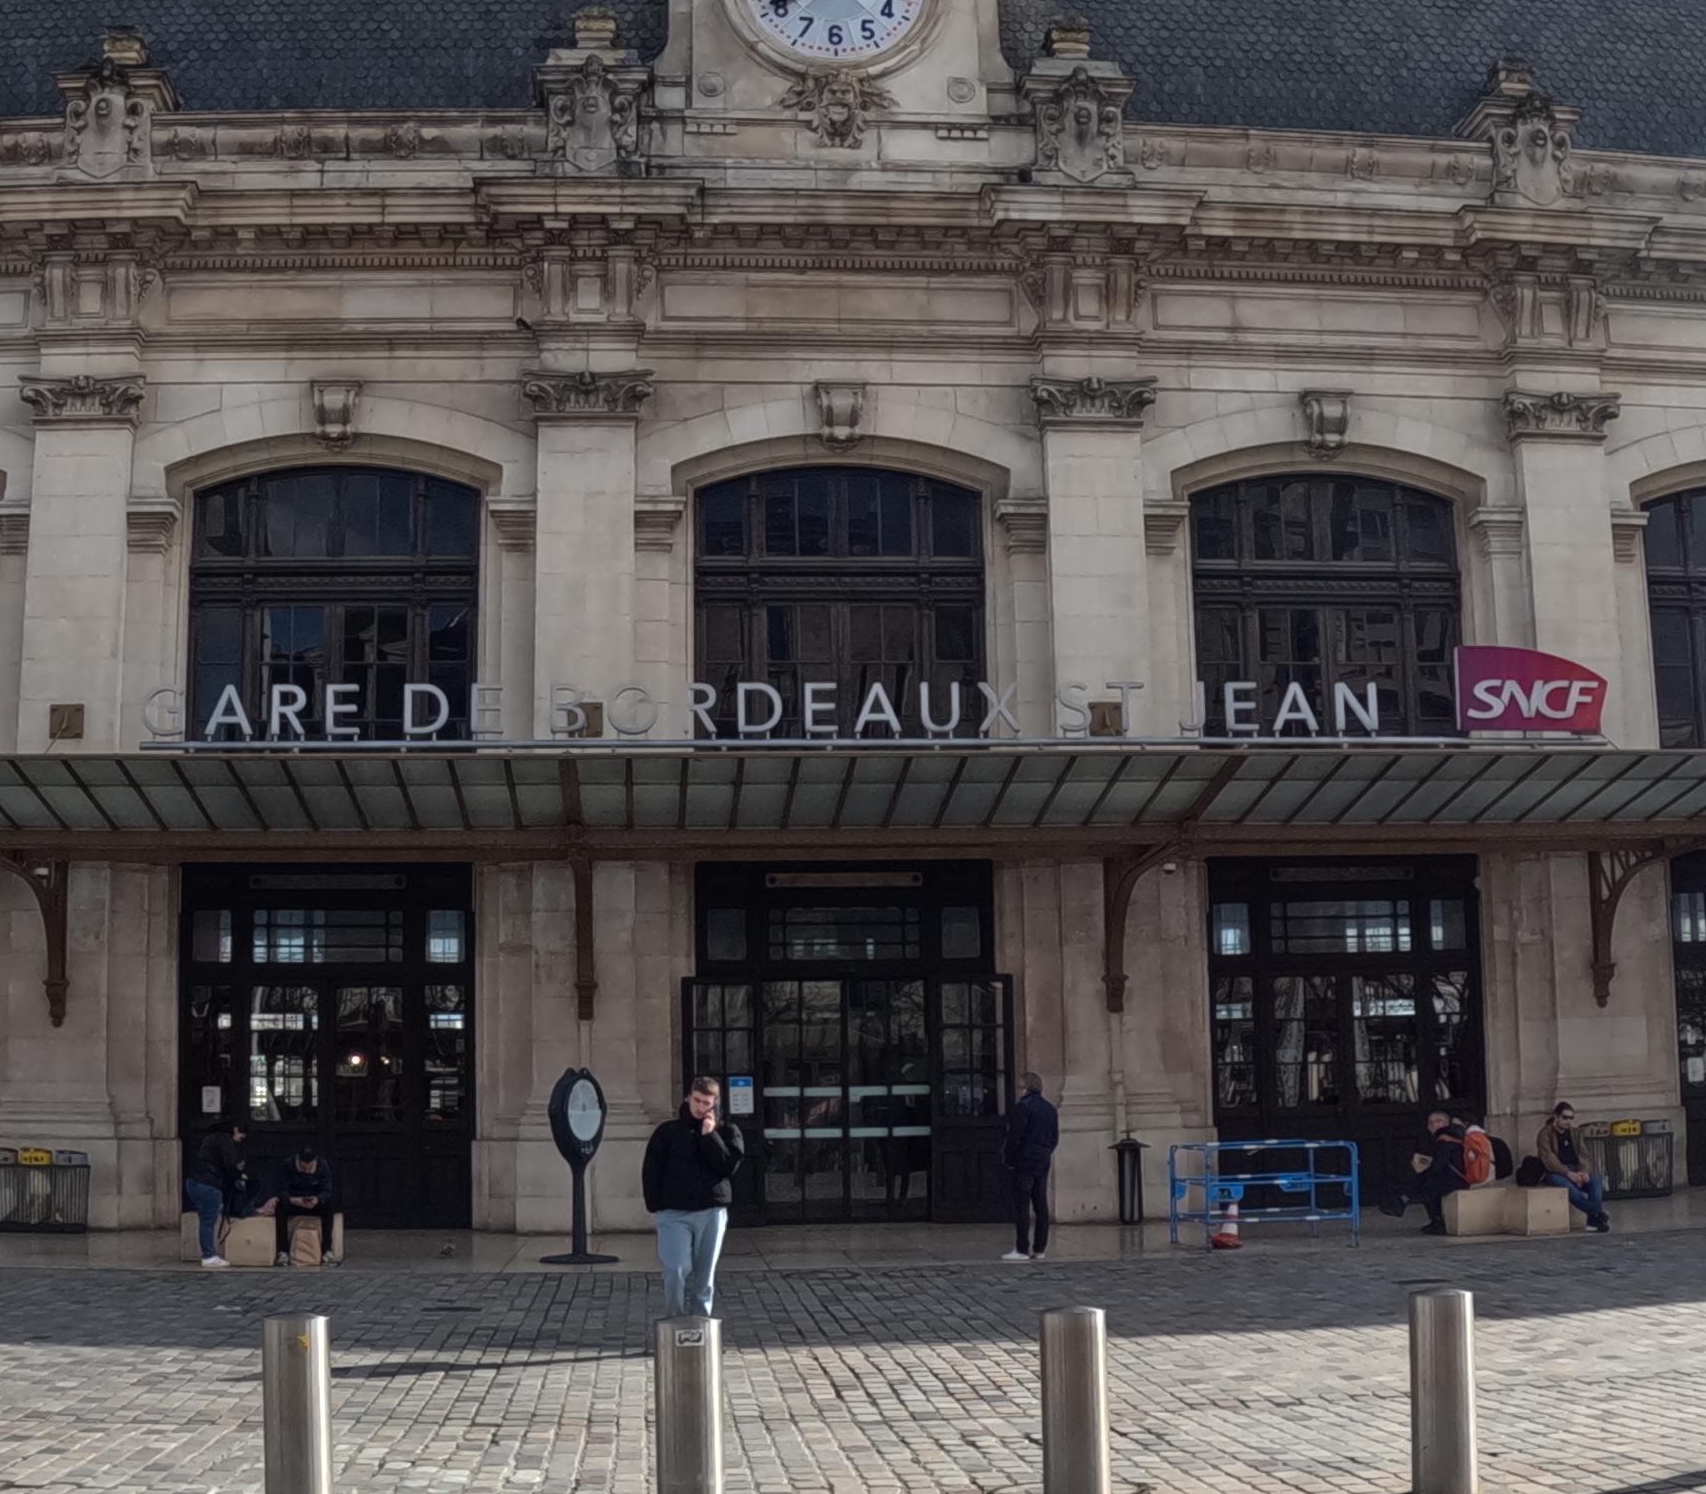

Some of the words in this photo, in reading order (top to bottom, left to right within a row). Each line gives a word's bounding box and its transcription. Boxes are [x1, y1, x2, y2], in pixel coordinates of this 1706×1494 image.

[799, 17, 814, 38] 7
[828, 25, 843, 46] 6
[861, 19, 875, 40] 5
[142, 683, 360, 736] GARE
[403, 683, 504, 735] DE
[549, 681, 1021, 735] BORDEAUX
[1059, 681, 1145, 734] ST
[1179, 681, 1378, 733] JEAN
[1466, 679, 1599, 720] SNCF
